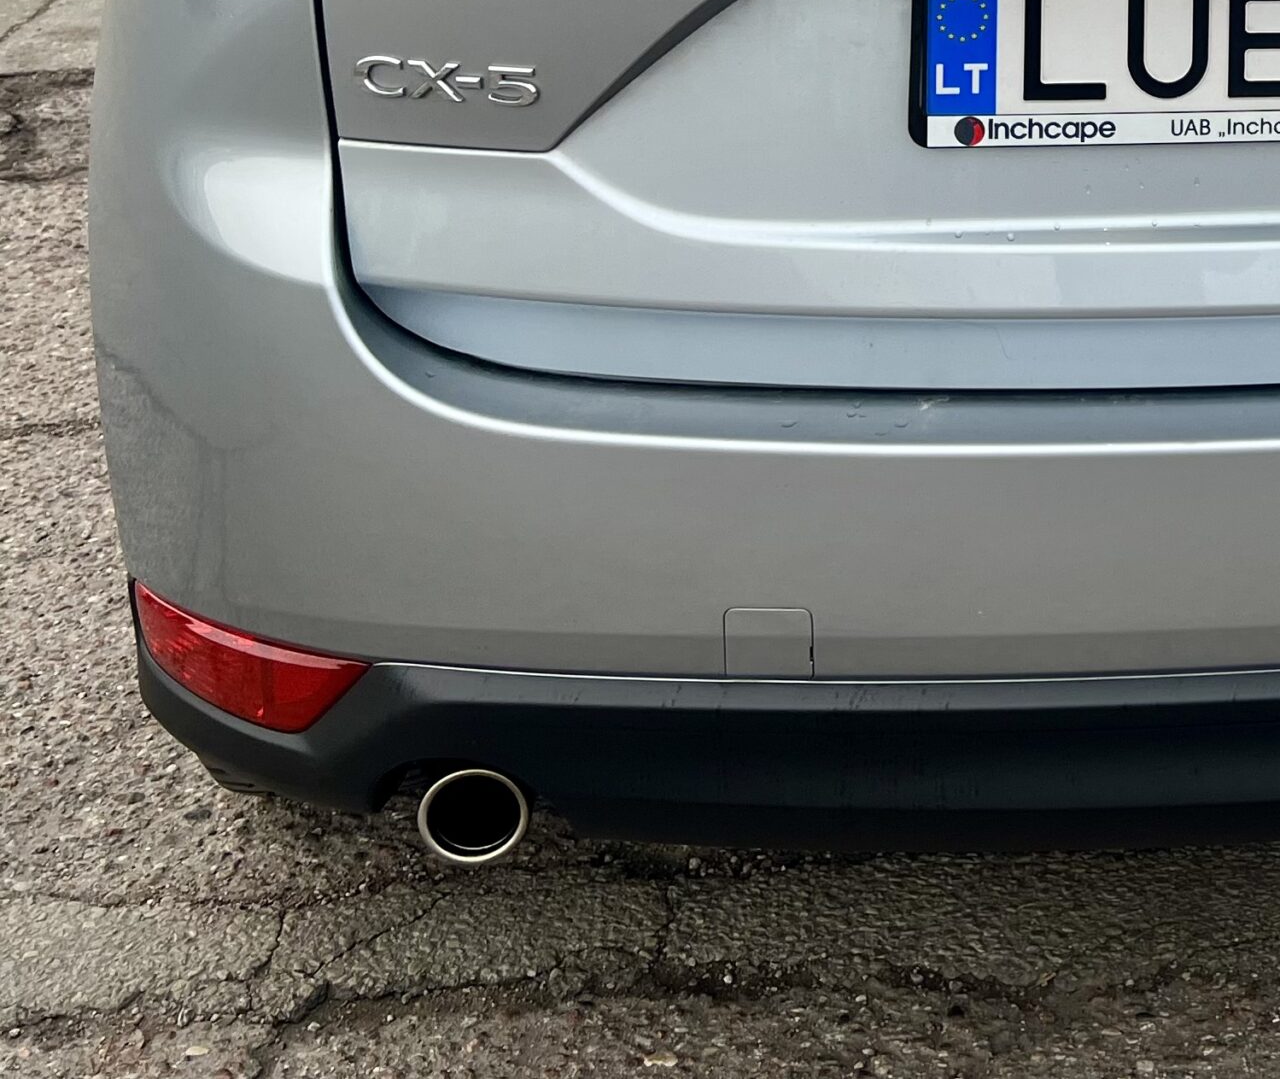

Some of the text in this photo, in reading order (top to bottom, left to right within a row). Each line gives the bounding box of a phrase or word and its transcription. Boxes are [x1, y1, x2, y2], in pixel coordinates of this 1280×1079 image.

[354, 55, 539, 107] CX-5
[935, 63, 989, 95] LT
[987, 118, 1117, 143] Inchcape
[1170, 119, 1212, 136] UAB
